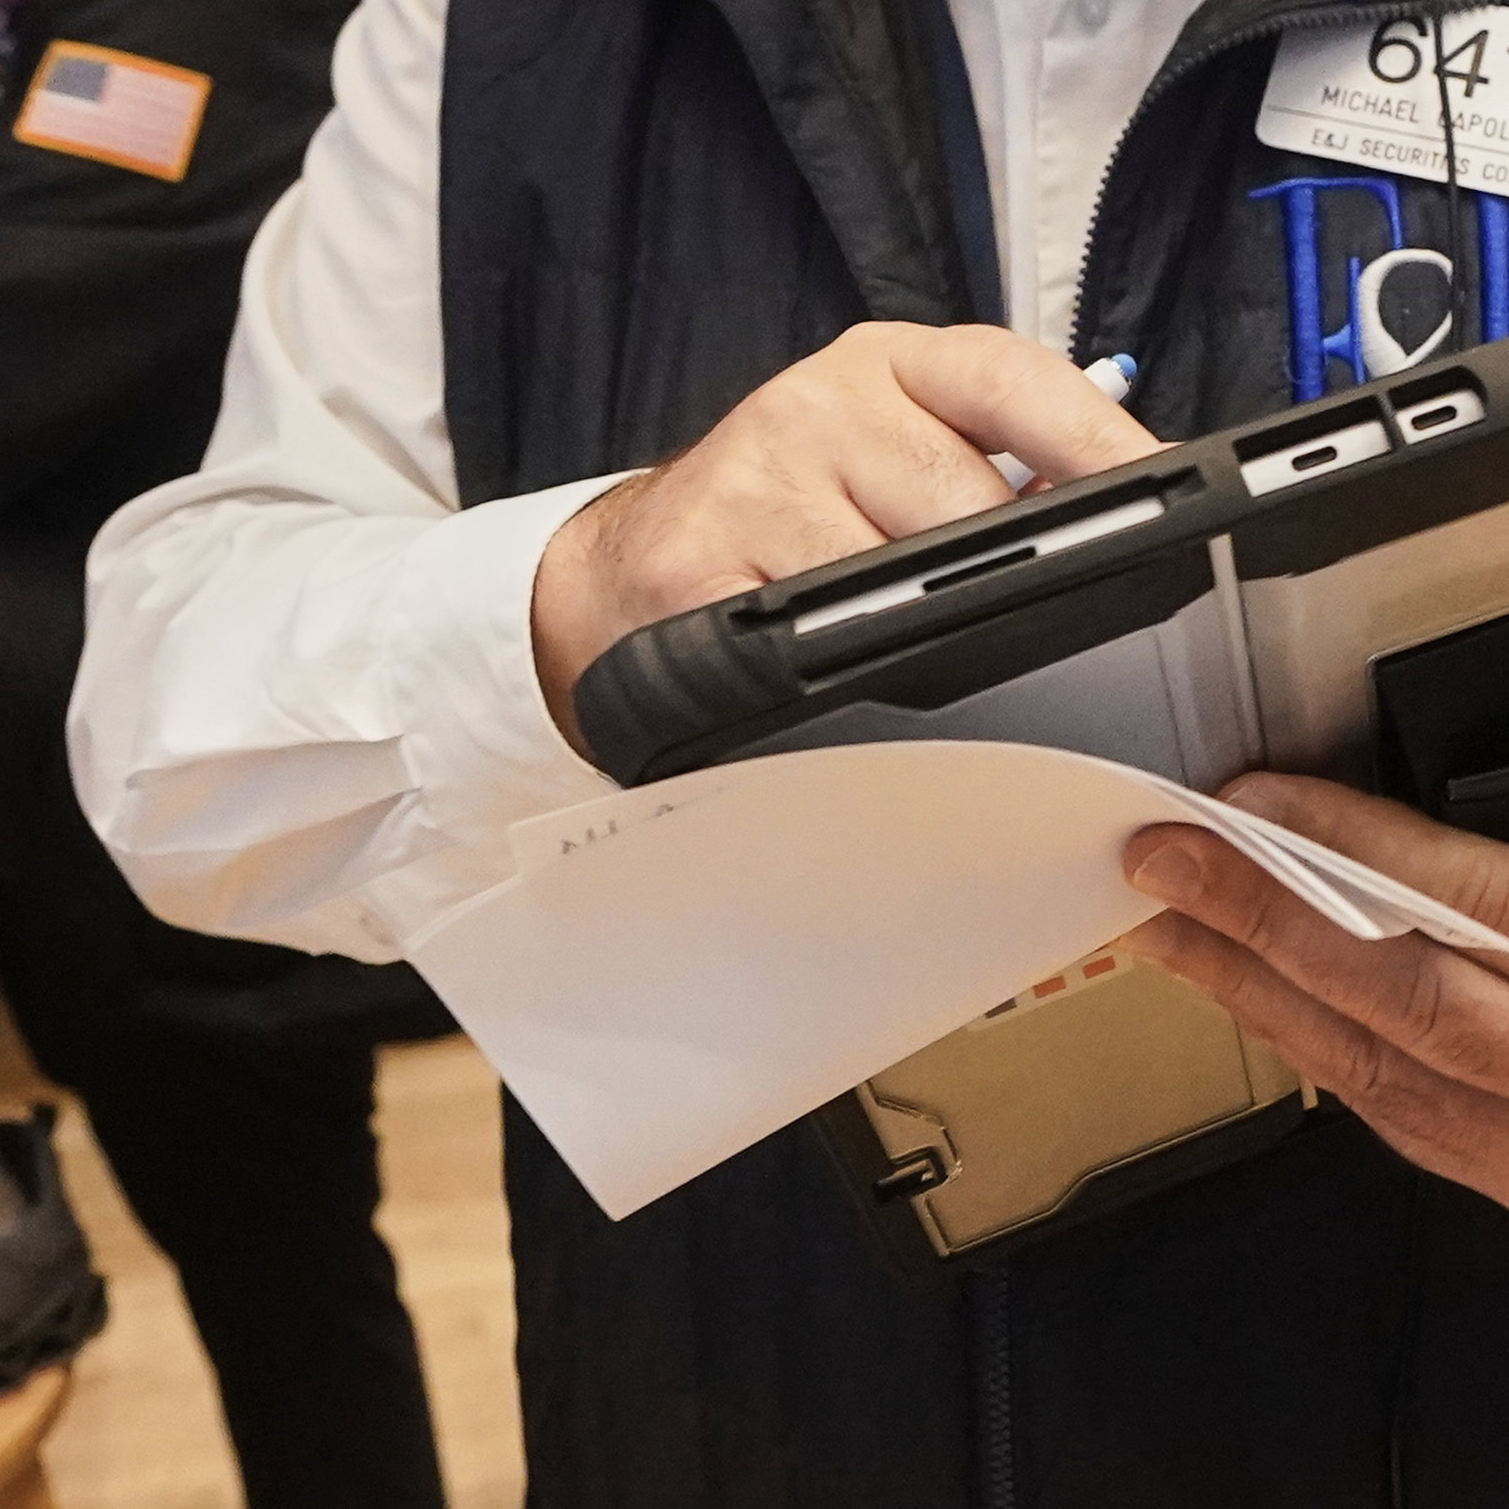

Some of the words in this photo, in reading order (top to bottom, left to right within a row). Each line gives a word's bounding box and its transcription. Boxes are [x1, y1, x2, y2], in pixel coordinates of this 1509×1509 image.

[1320, 85, 1420, 124] MICHAEL
[1311, 128, 1349, 151] E&J
[1359, 137, 1471, 176] SECURITIS
